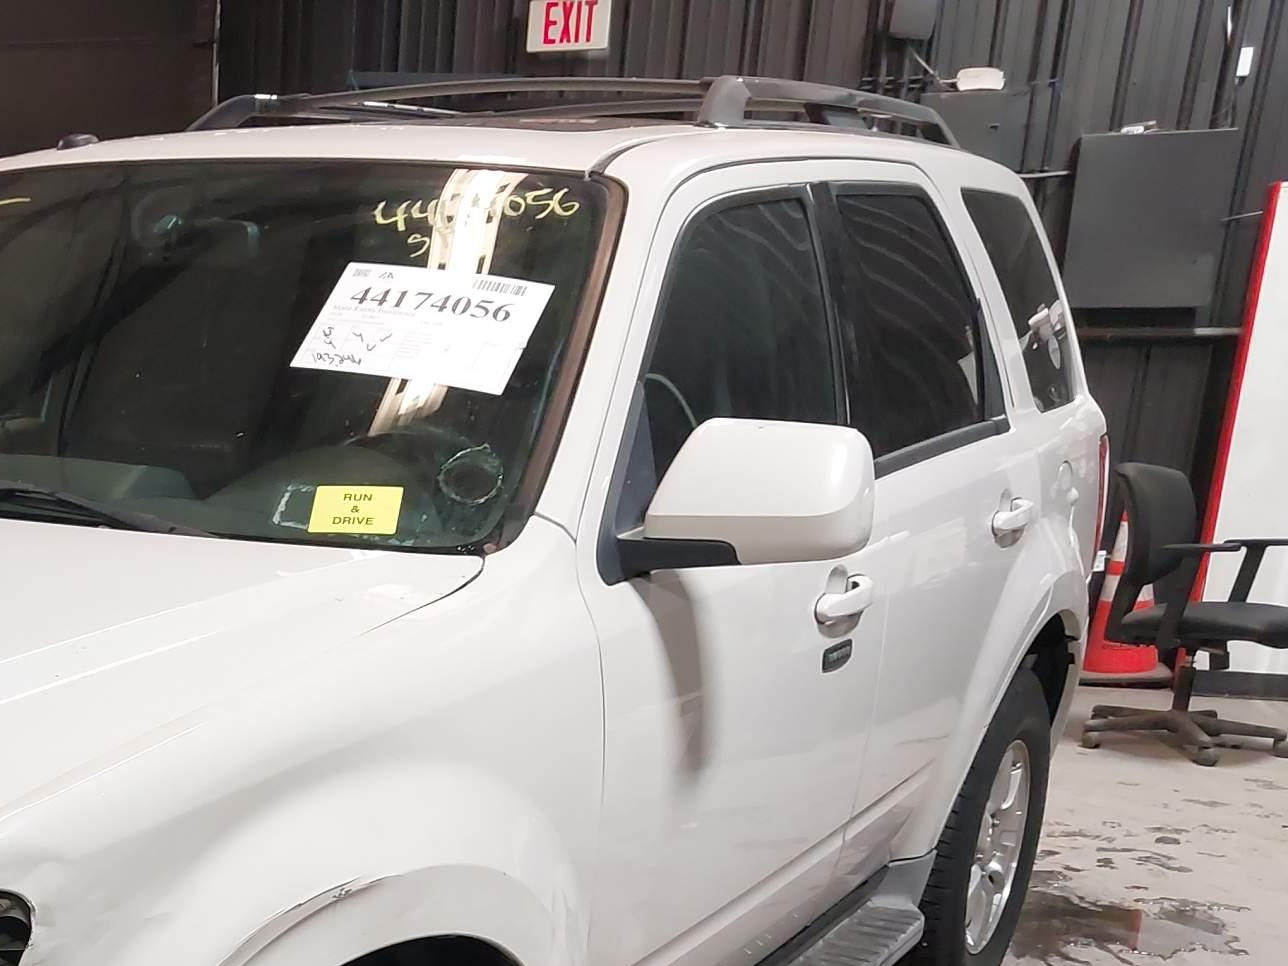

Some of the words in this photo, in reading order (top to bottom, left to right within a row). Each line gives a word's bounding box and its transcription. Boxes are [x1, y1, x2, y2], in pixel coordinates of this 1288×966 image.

[543, 0, 598, 44] EXIT
[351, 286, 516, 323] 44174056
[343, 493, 373, 502] RUN
[351, 505, 360, 513] &
[332, 517, 373, 525] DRIVE
